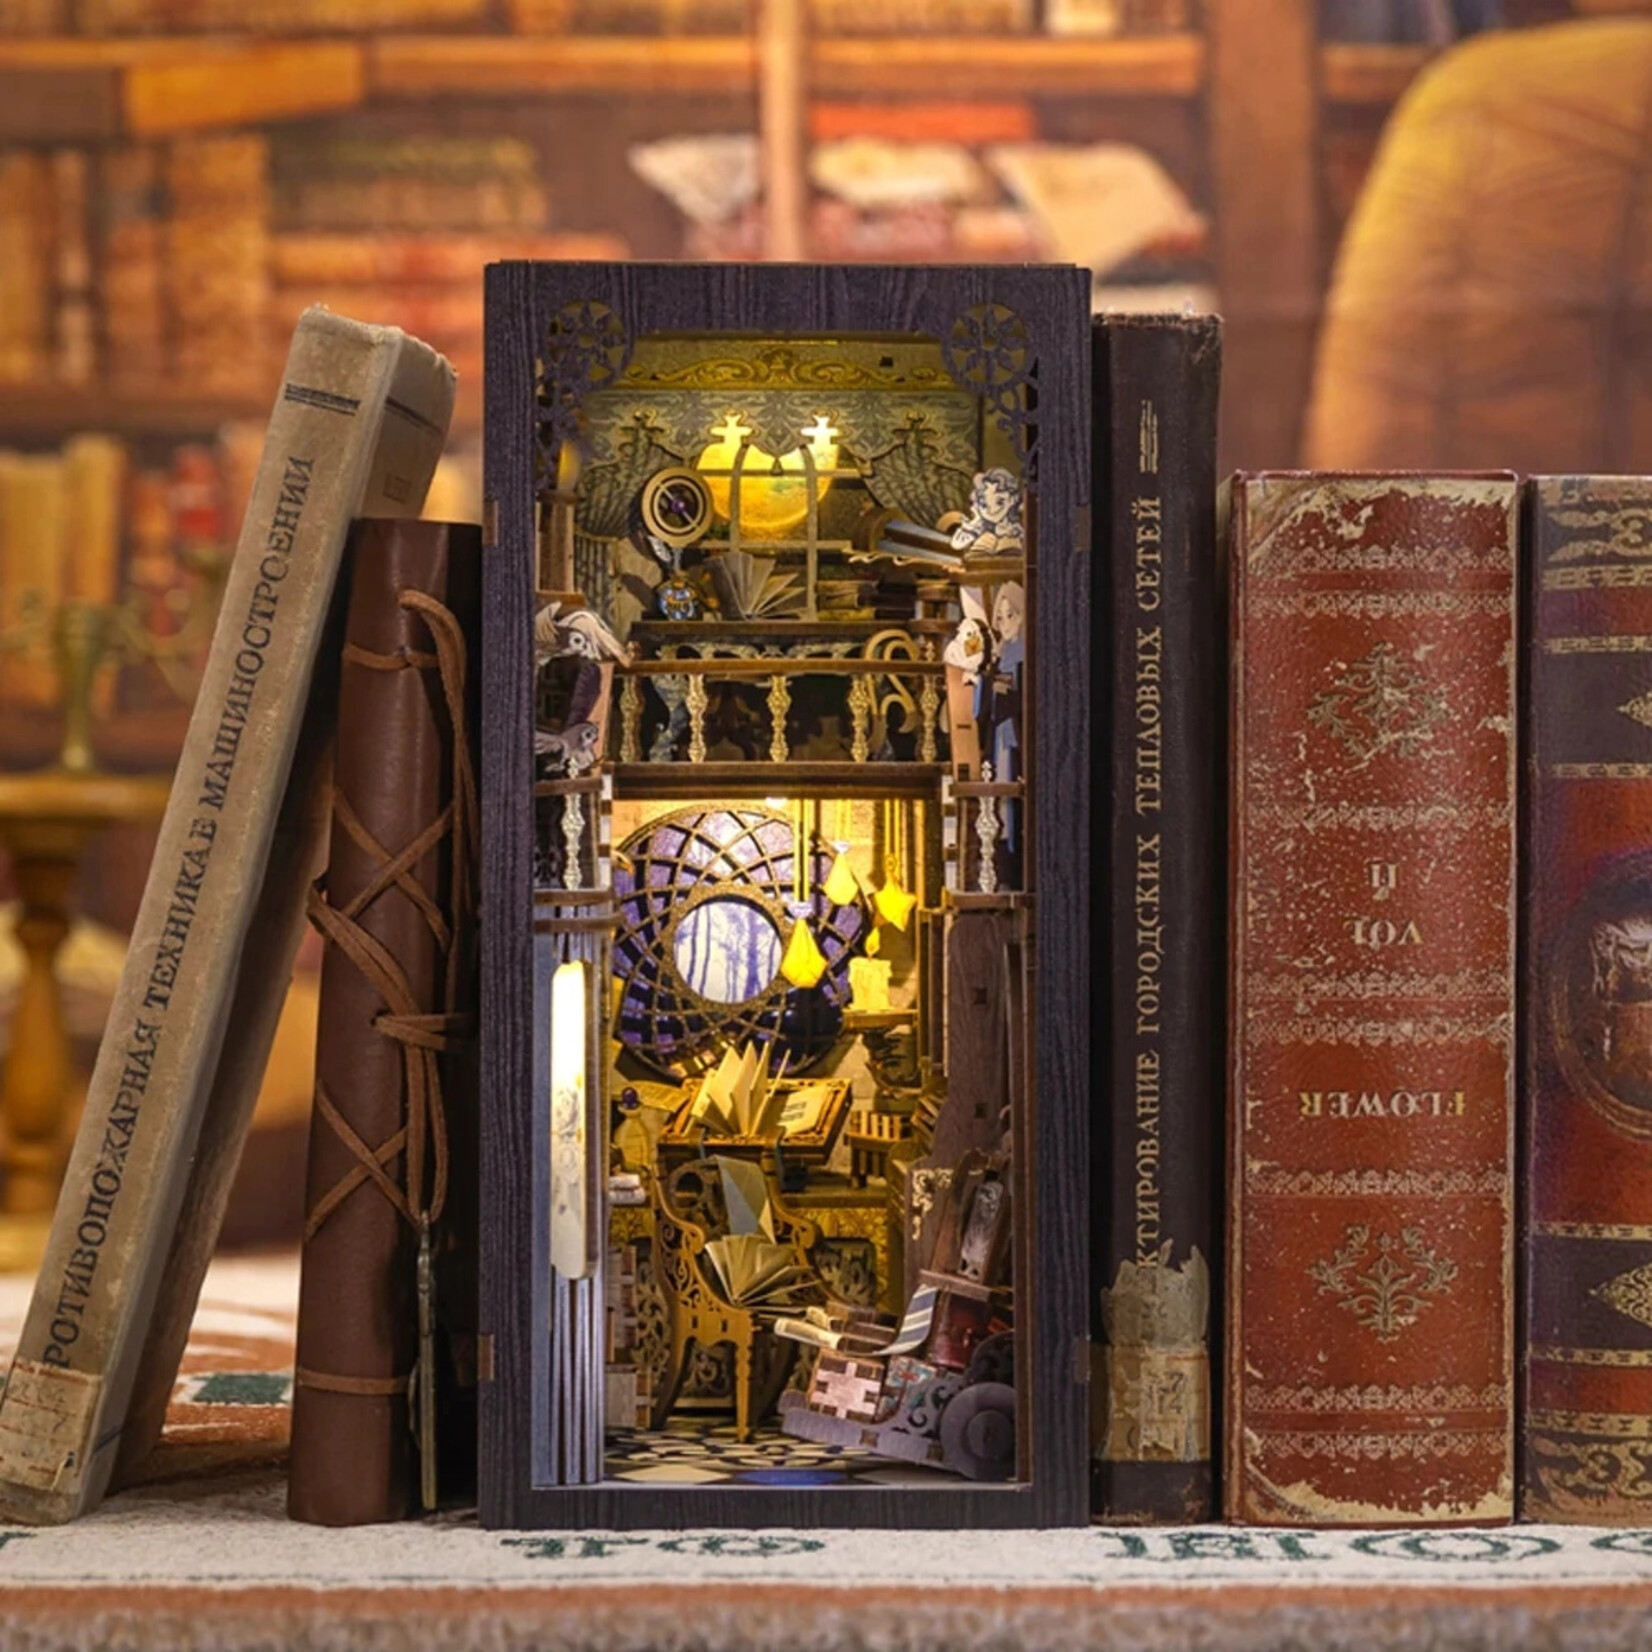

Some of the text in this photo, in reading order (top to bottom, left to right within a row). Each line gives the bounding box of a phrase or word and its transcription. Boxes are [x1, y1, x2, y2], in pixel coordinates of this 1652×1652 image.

[43, 456, 314, 1369] РОТИВОПОЖАРНАЯ ТЕХНИКА В МАШИНОСТРОЕНИИ
[1131, 496, 1166, 1271] КТИРОВАНИЕ ГОРОДСКИХ ТЕПЛОВЫХ СЕТЕЙ
[1343, 918, 1424, 948] VOL
[1299, 1089, 1467, 1119] FLOWER
